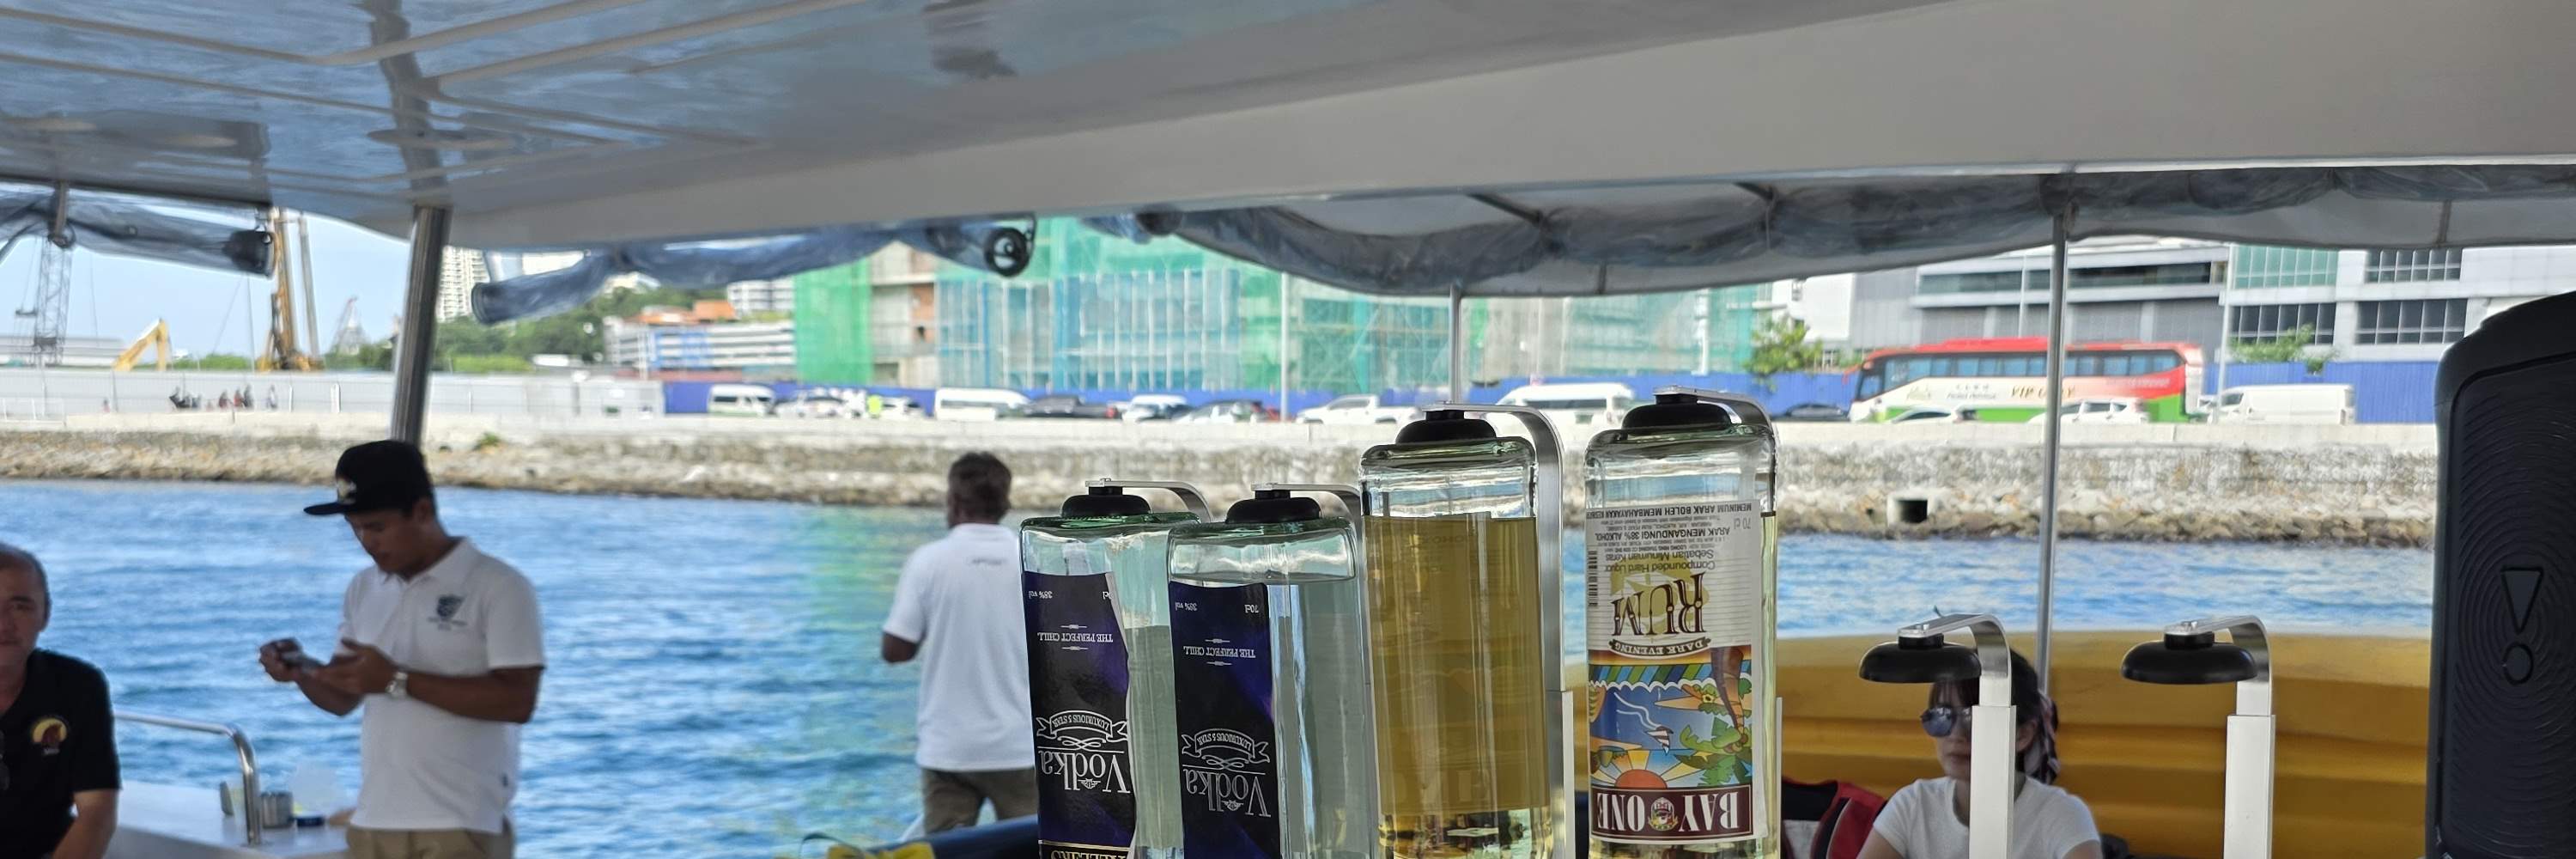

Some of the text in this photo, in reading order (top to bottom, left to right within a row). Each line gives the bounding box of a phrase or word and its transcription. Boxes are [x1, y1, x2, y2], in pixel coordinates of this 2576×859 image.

[2011, 384, 2034, 399] VIP
[1665, 506, 1692, 515] BOLEH
[1693, 505, 1716, 515] ARAK
[1717, 503, 1752, 514] MEMINUM
[1733, 517, 1741, 530] cl
[1742, 517, 1752, 530] 70
[1595, 527, 1730, 541] ARAK MENGANDUNGI 38% ALKOHOL
[1605, 549, 1715, 562] Sebatian Minuman Keras
[1629, 562, 1649, 573] Hard
[1651, 559, 1716, 570] Compounded
[1244, 604, 1260, 613] 70cl
[1610, 571, 1707, 637] RUM
[1036, 632, 1114, 643] THE PERFECT CHILL
[1183, 646, 1256, 658] THE PERFECT CHILL
[1614, 639, 1704, 655] DARK EVENING
[1053, 715, 1068, 728] STAR
[1072, 714, 1110, 732] LUXURIOUS
[1196, 733, 1212, 746] STAR
[1217, 733, 1252, 752] LUXURIOUS
[1038, 750, 1131, 794] Vodka
[1183, 768, 1272, 818] Vodka
[1596, 791, 1740, 832] BAY ONE
